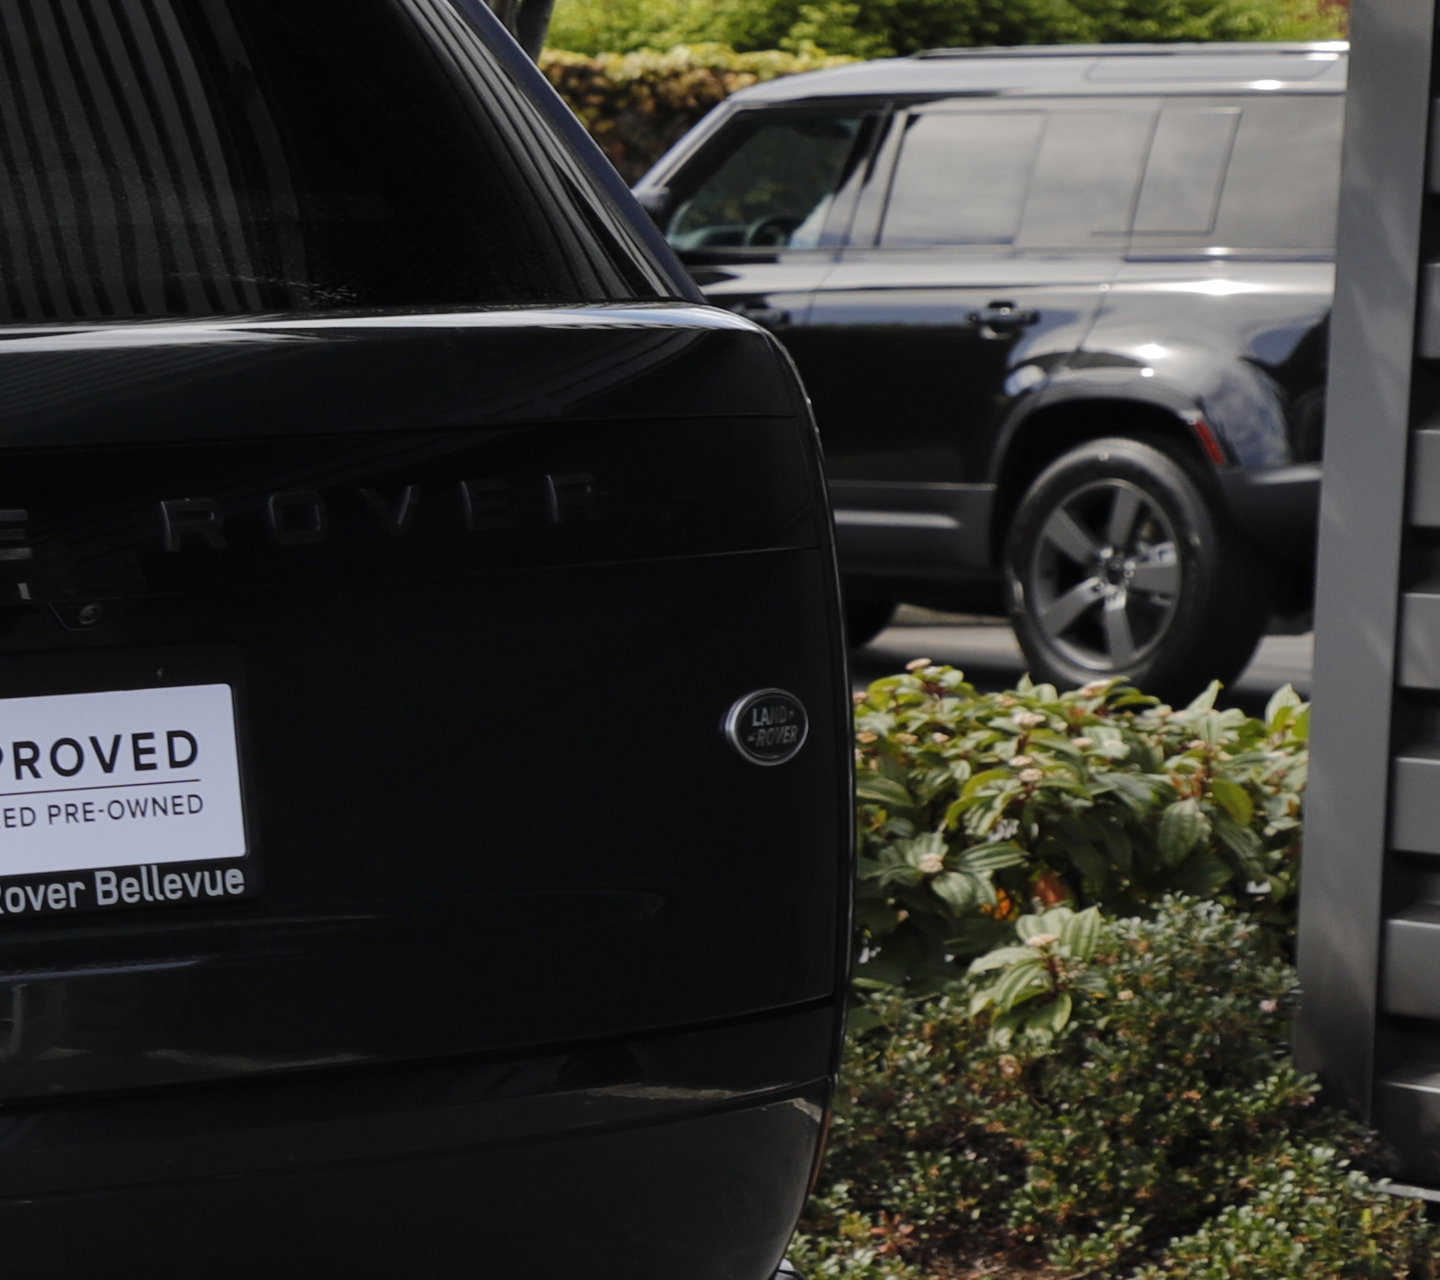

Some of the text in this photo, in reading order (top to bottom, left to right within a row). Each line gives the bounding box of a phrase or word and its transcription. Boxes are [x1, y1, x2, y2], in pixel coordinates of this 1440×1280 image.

[160, 472, 601, 553] ROVER
[752, 706, 786, 726] LAND
[756, 726, 798, 747] ROVER
[47, 793, 205, 826] PRE-OWNED
[94, 865, 246, 907] Bellevue
